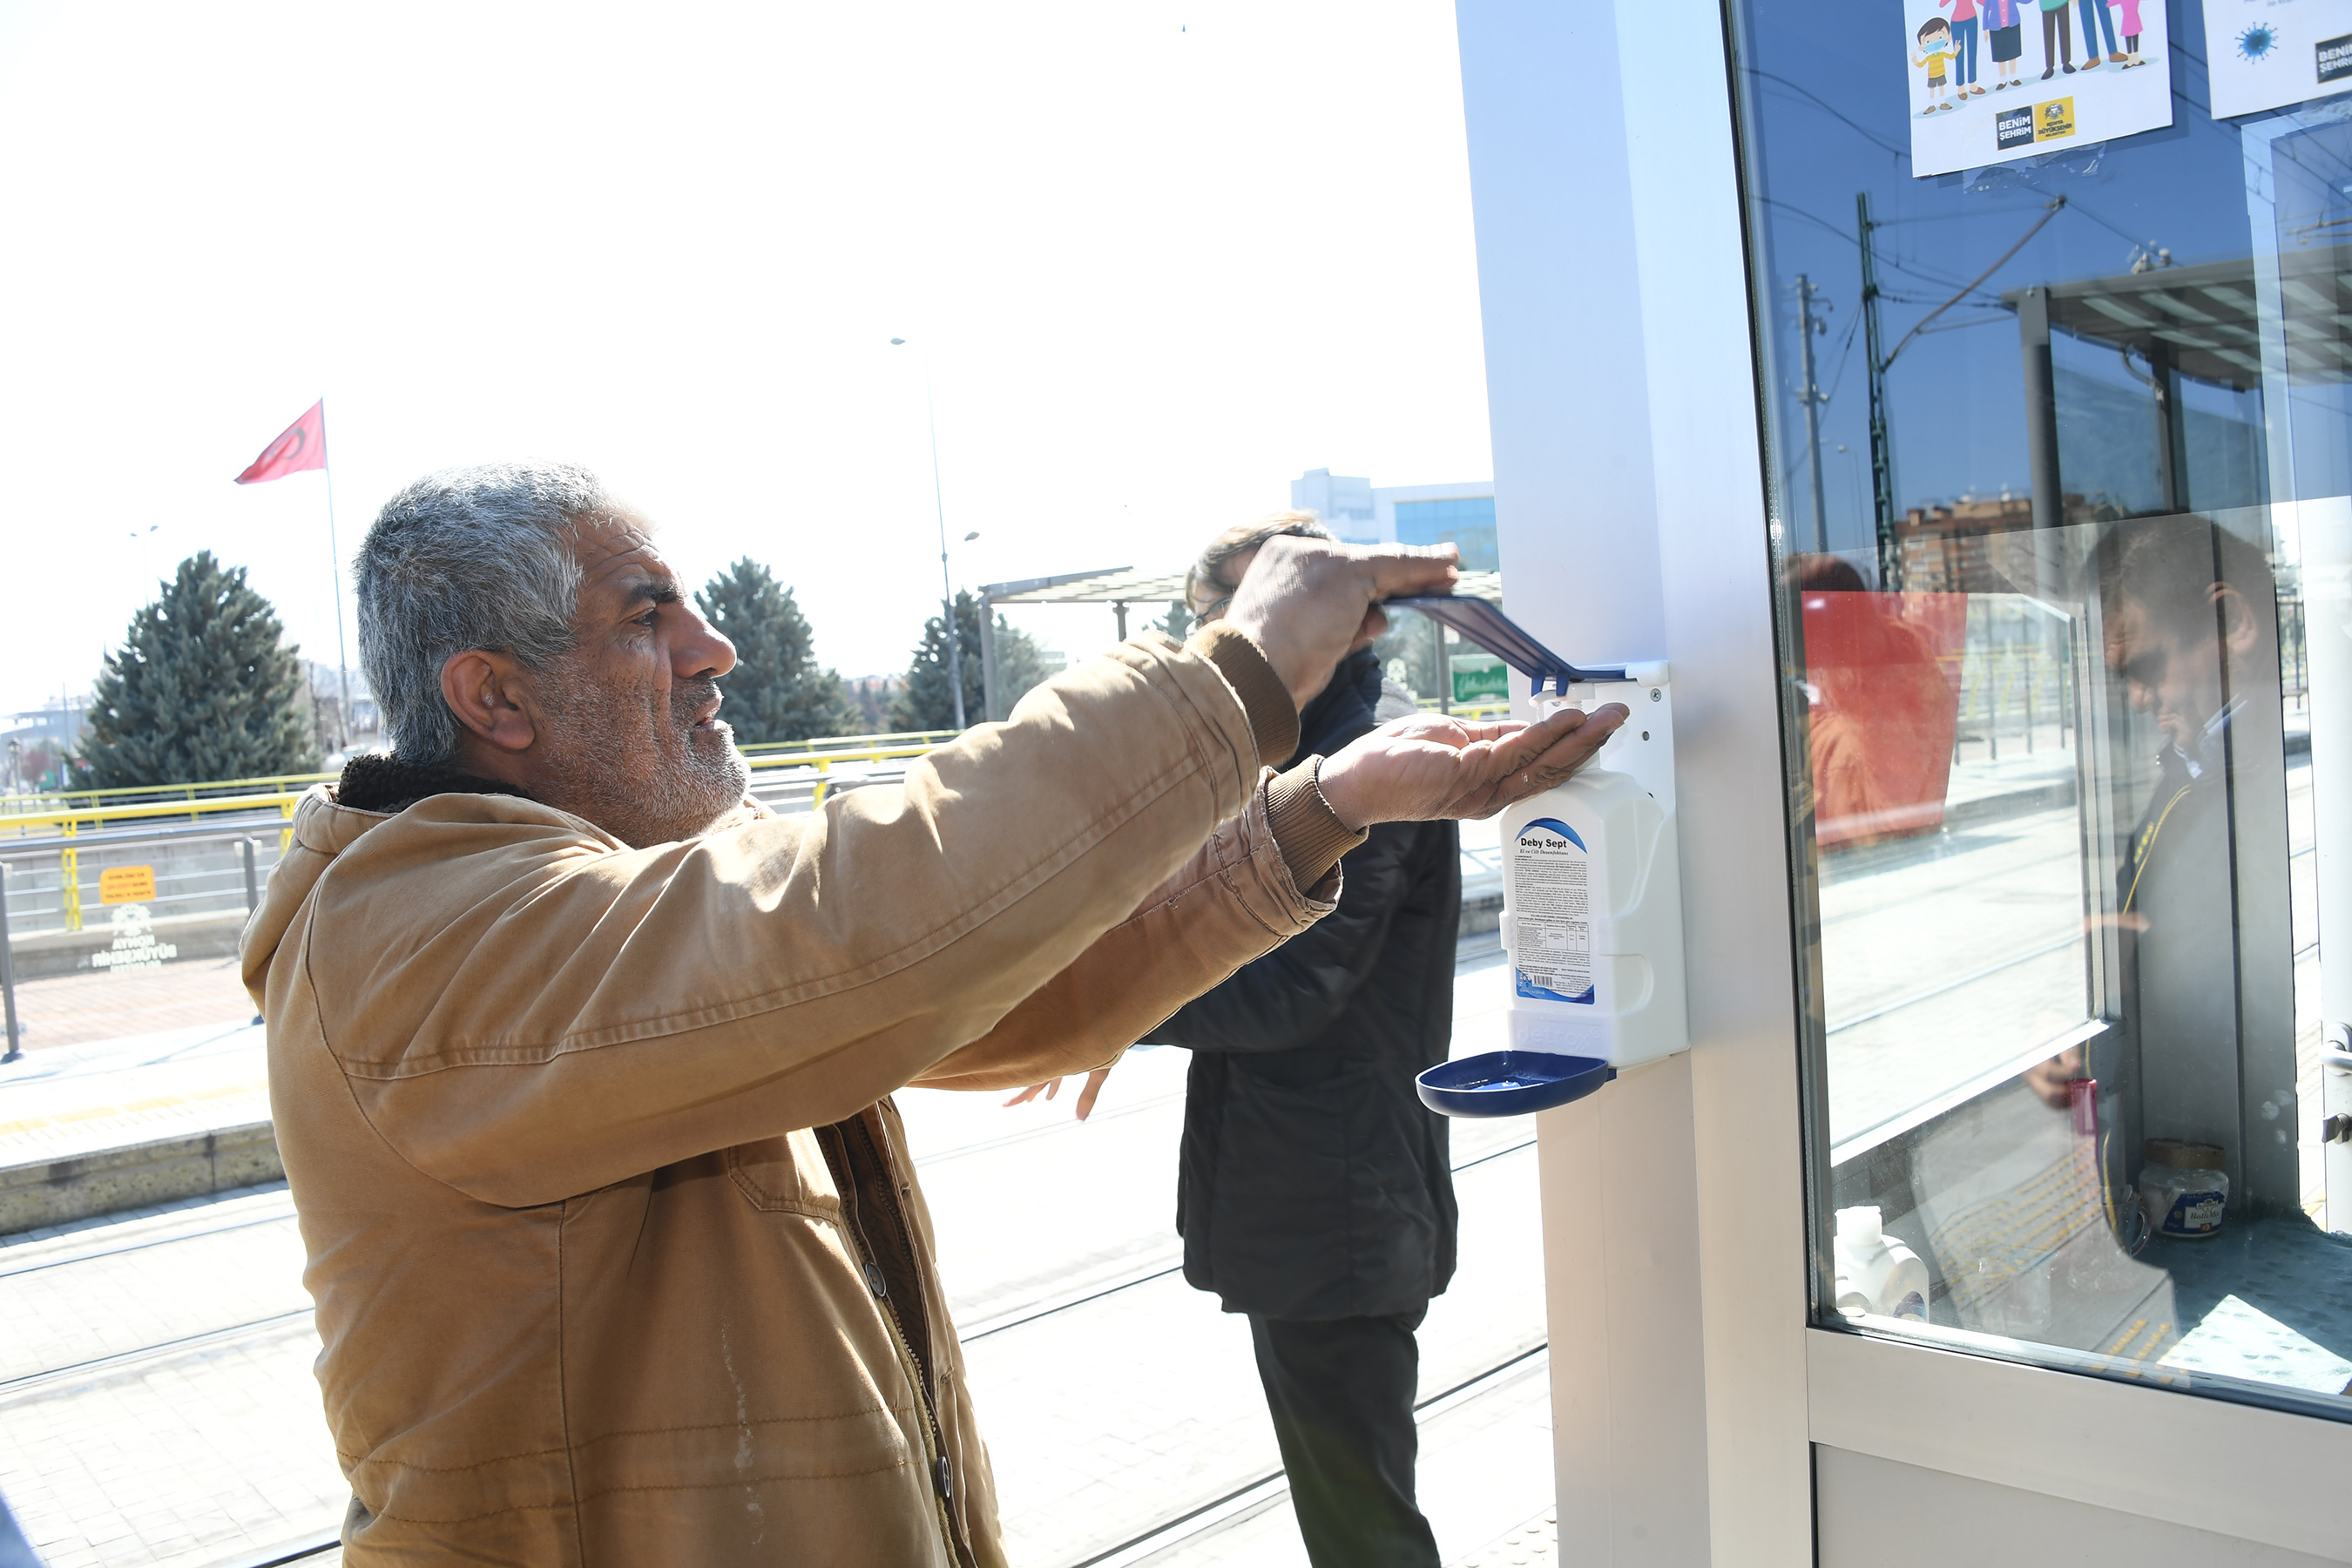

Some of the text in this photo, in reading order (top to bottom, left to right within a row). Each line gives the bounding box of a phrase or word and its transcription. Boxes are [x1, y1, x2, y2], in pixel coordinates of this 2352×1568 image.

[2318, 44, 2352, 62] BENİ
[2319, 55, 2352, 73] ŞEHRİ
[1521, 838, 1567, 849] Deby Sept
